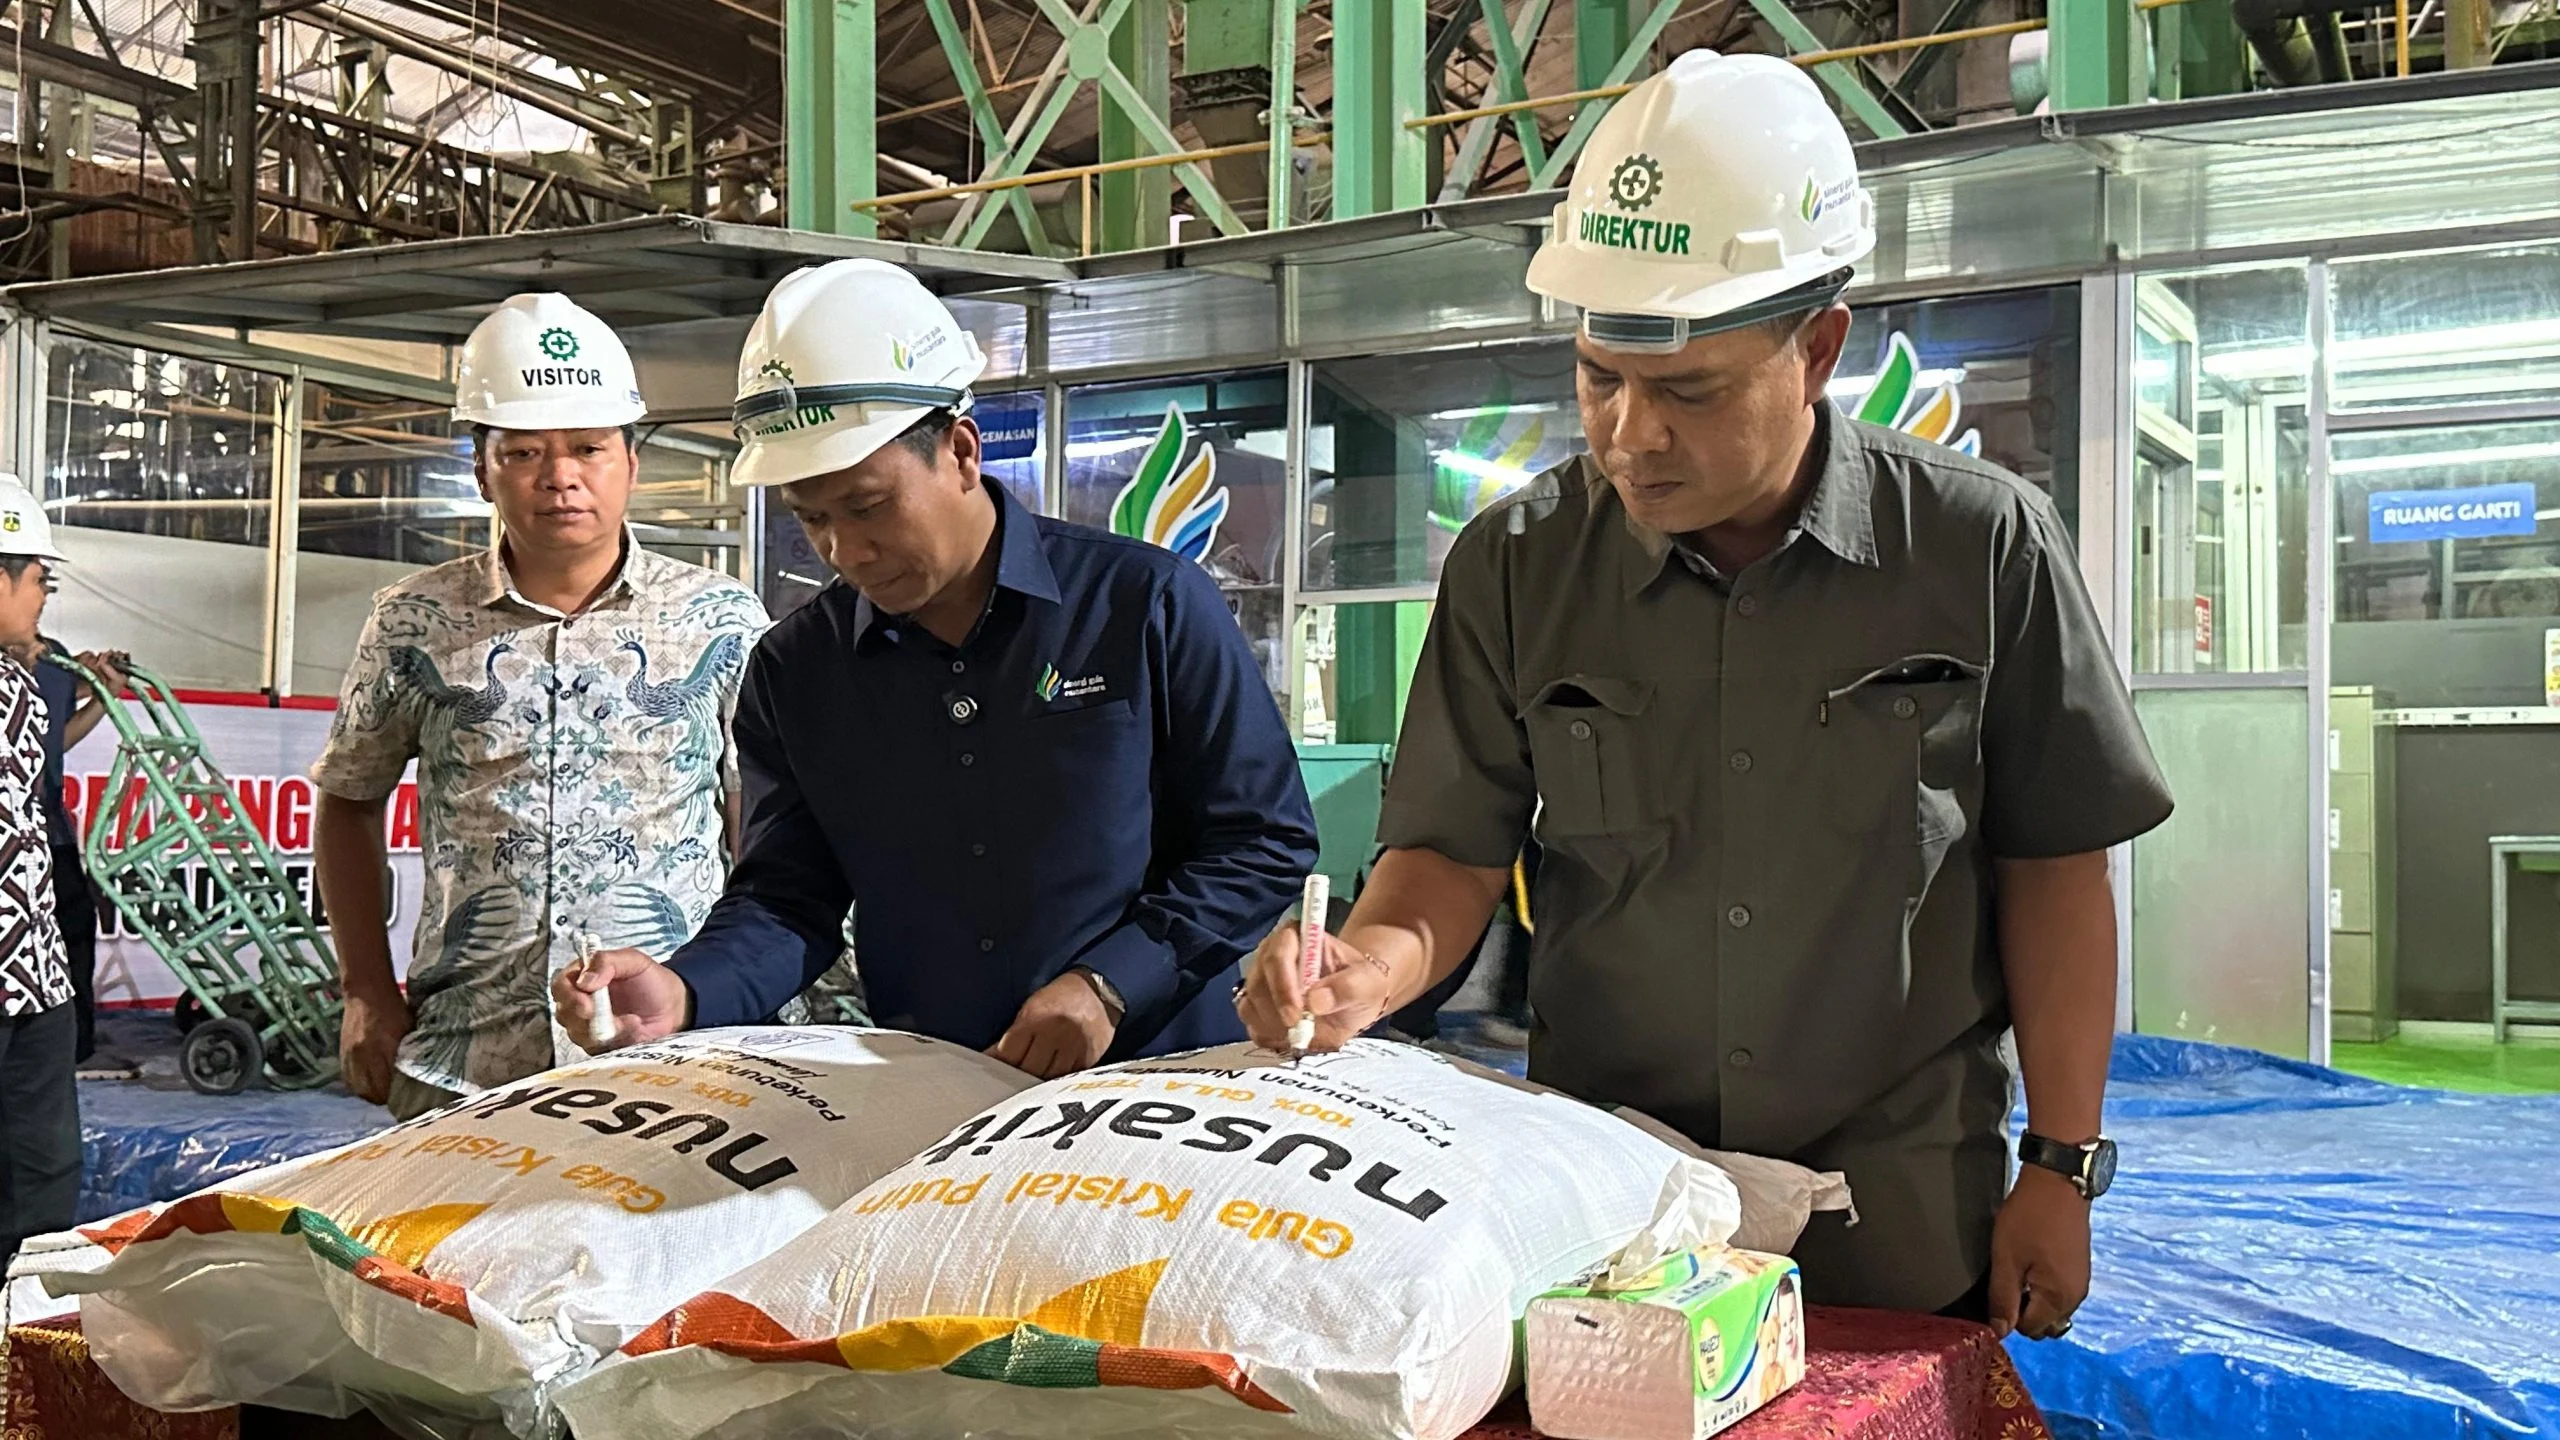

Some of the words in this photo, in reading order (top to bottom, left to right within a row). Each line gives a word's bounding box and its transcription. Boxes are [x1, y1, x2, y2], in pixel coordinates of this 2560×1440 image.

[1580, 211, 1691, 255] DIREKTUR
[521, 367, 603, 387] VISITOR
[2383, 504, 2455, 526] RUANG
[2457, 500, 2522, 522] GANTI
[1163, 1079, 1257, 1103] GULA
[1259, 1072, 1452, 1149] Perkebunan
[1274, 1096, 1356, 1129] 100%
[888, 1097, 1451, 1222] nusakit
[559, 1163, 667, 1214] Gula
[1004, 1171, 1194, 1222] Kristal
[1217, 1199, 1354, 1260] Gula
